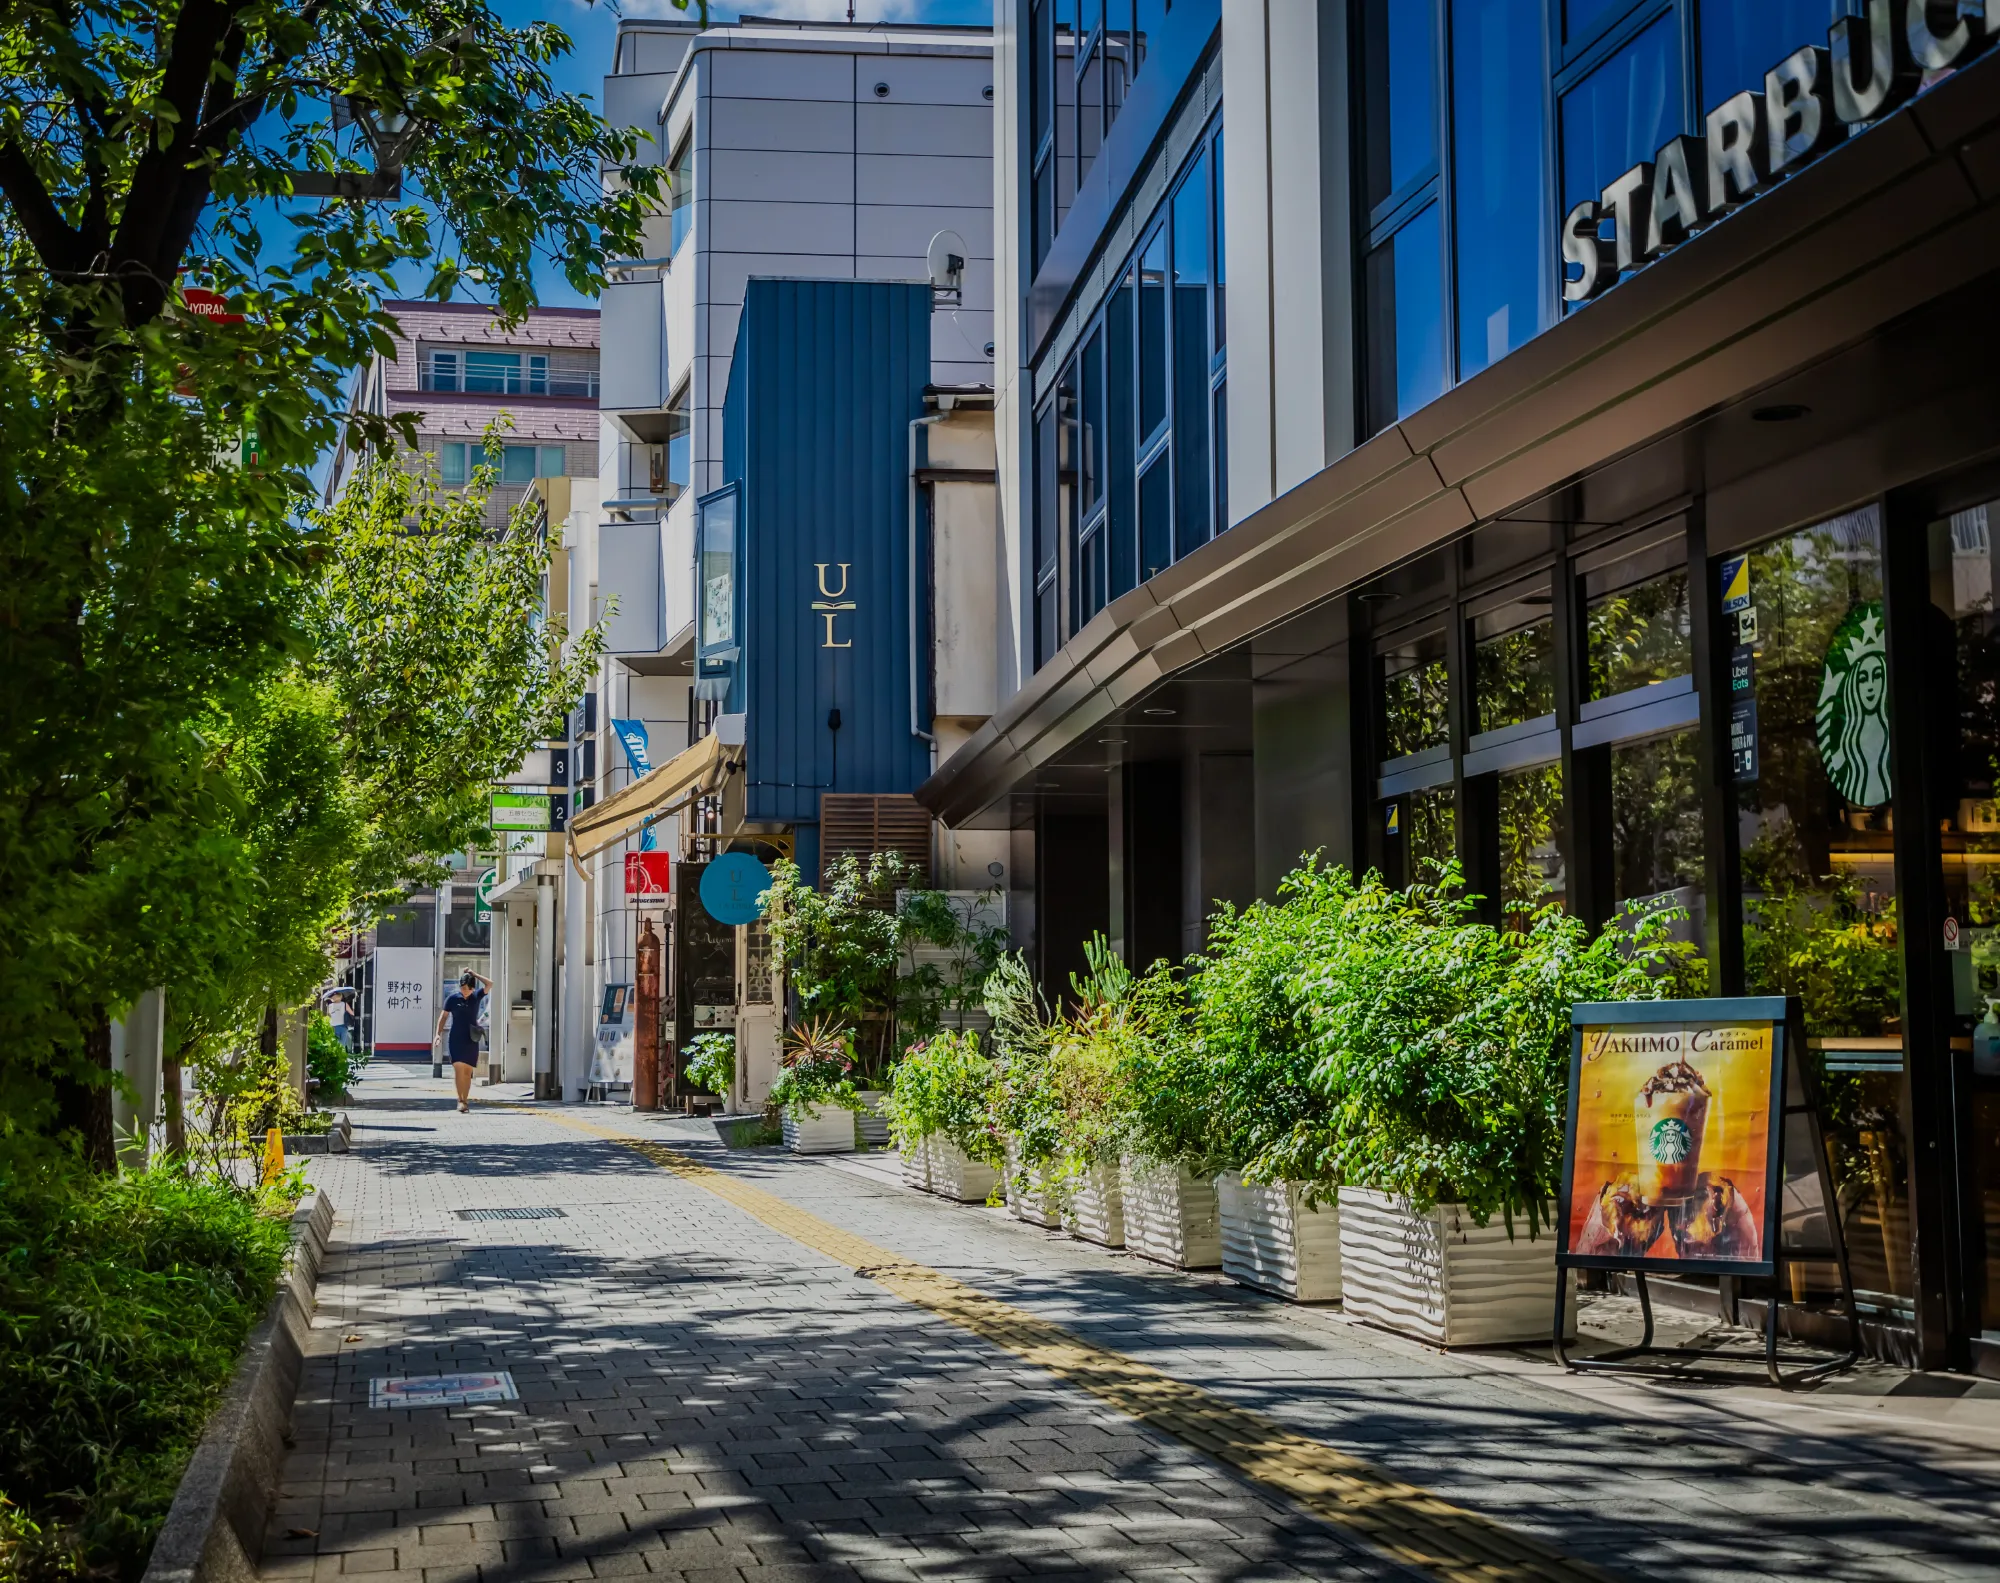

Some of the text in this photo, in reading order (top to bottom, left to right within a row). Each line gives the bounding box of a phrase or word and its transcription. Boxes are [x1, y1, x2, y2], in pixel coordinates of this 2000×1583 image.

[1562, 0, 2000, 301] STARBUC
[188, 302, 228, 315] HYDRAN
[813, 563, 851, 597] U
[821, 613, 852, 647] L
[1732, 665, 1748, 678] Uber
[1732, 678, 1749, 691] Eats
[556, 760, 564, 774] 3
[556, 806, 564, 819] 2
[387, 980, 423, 994] 野村の
[1587, 1026, 1763, 1061] YAKIIMO Caramel
